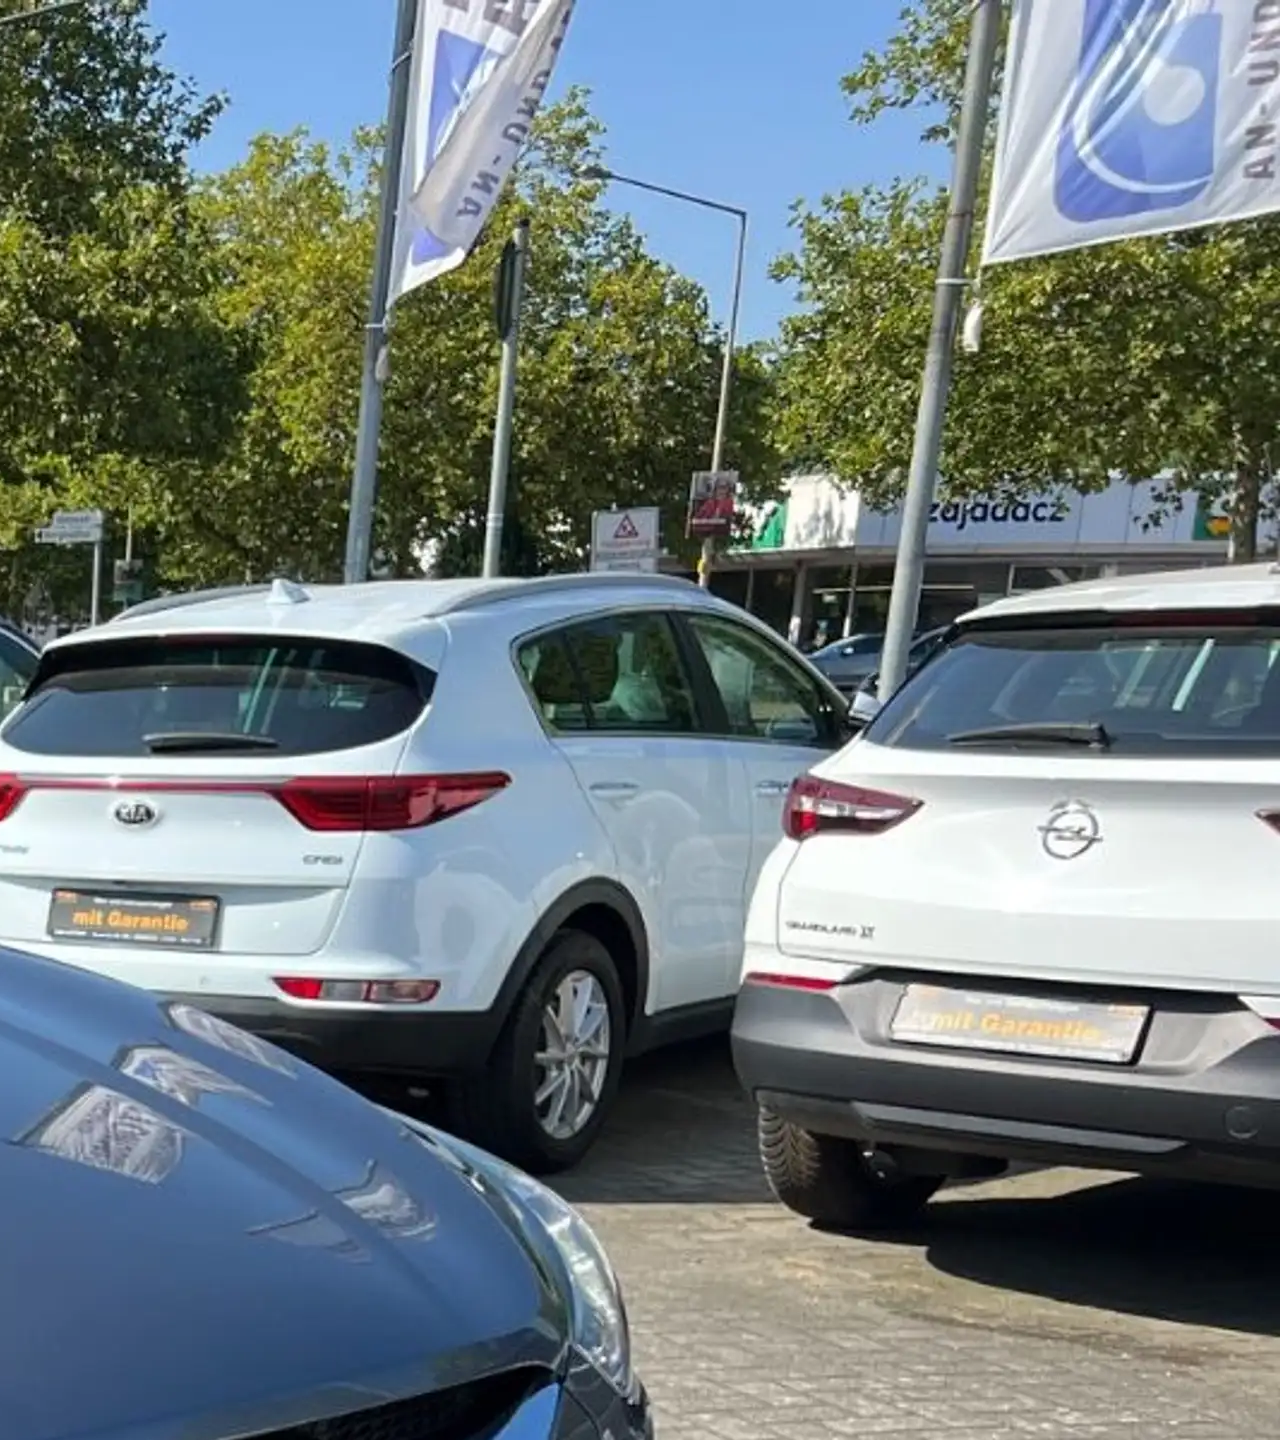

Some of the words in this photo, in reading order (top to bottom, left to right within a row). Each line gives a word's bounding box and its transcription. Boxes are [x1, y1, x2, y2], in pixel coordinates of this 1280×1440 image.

[117, 804, 152, 823] KIA
[72, 908, 103, 927] mit
[107, 909, 189, 932] Garantie
[931, 1011, 976, 1030] mit
[981, 1012, 1102, 1040] Garantie
